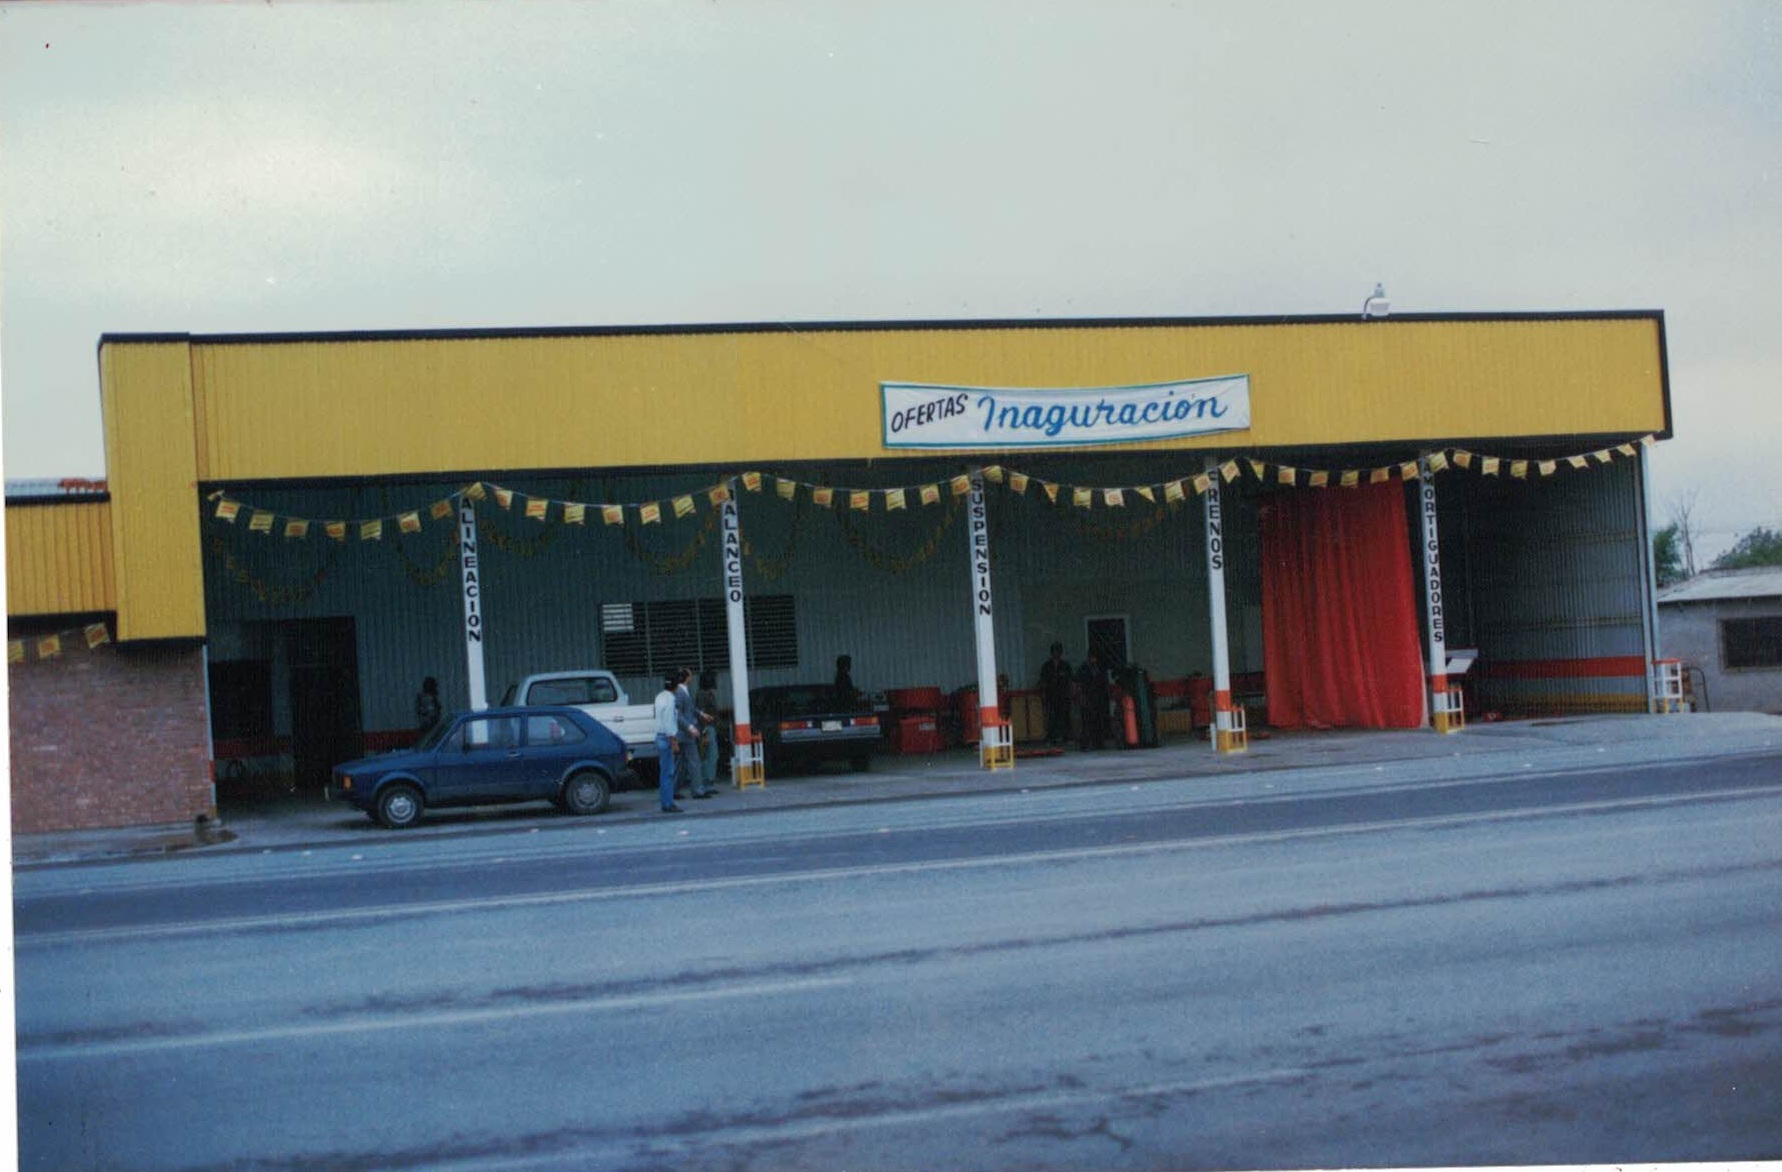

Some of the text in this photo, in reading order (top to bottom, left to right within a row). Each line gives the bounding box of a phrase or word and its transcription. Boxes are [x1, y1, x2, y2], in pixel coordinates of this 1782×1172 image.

[891, 393, 967, 432] OFERTAS
[461, 497, 481, 642] ALINEACION
[971, 479, 991, 615] SUSPENSION
